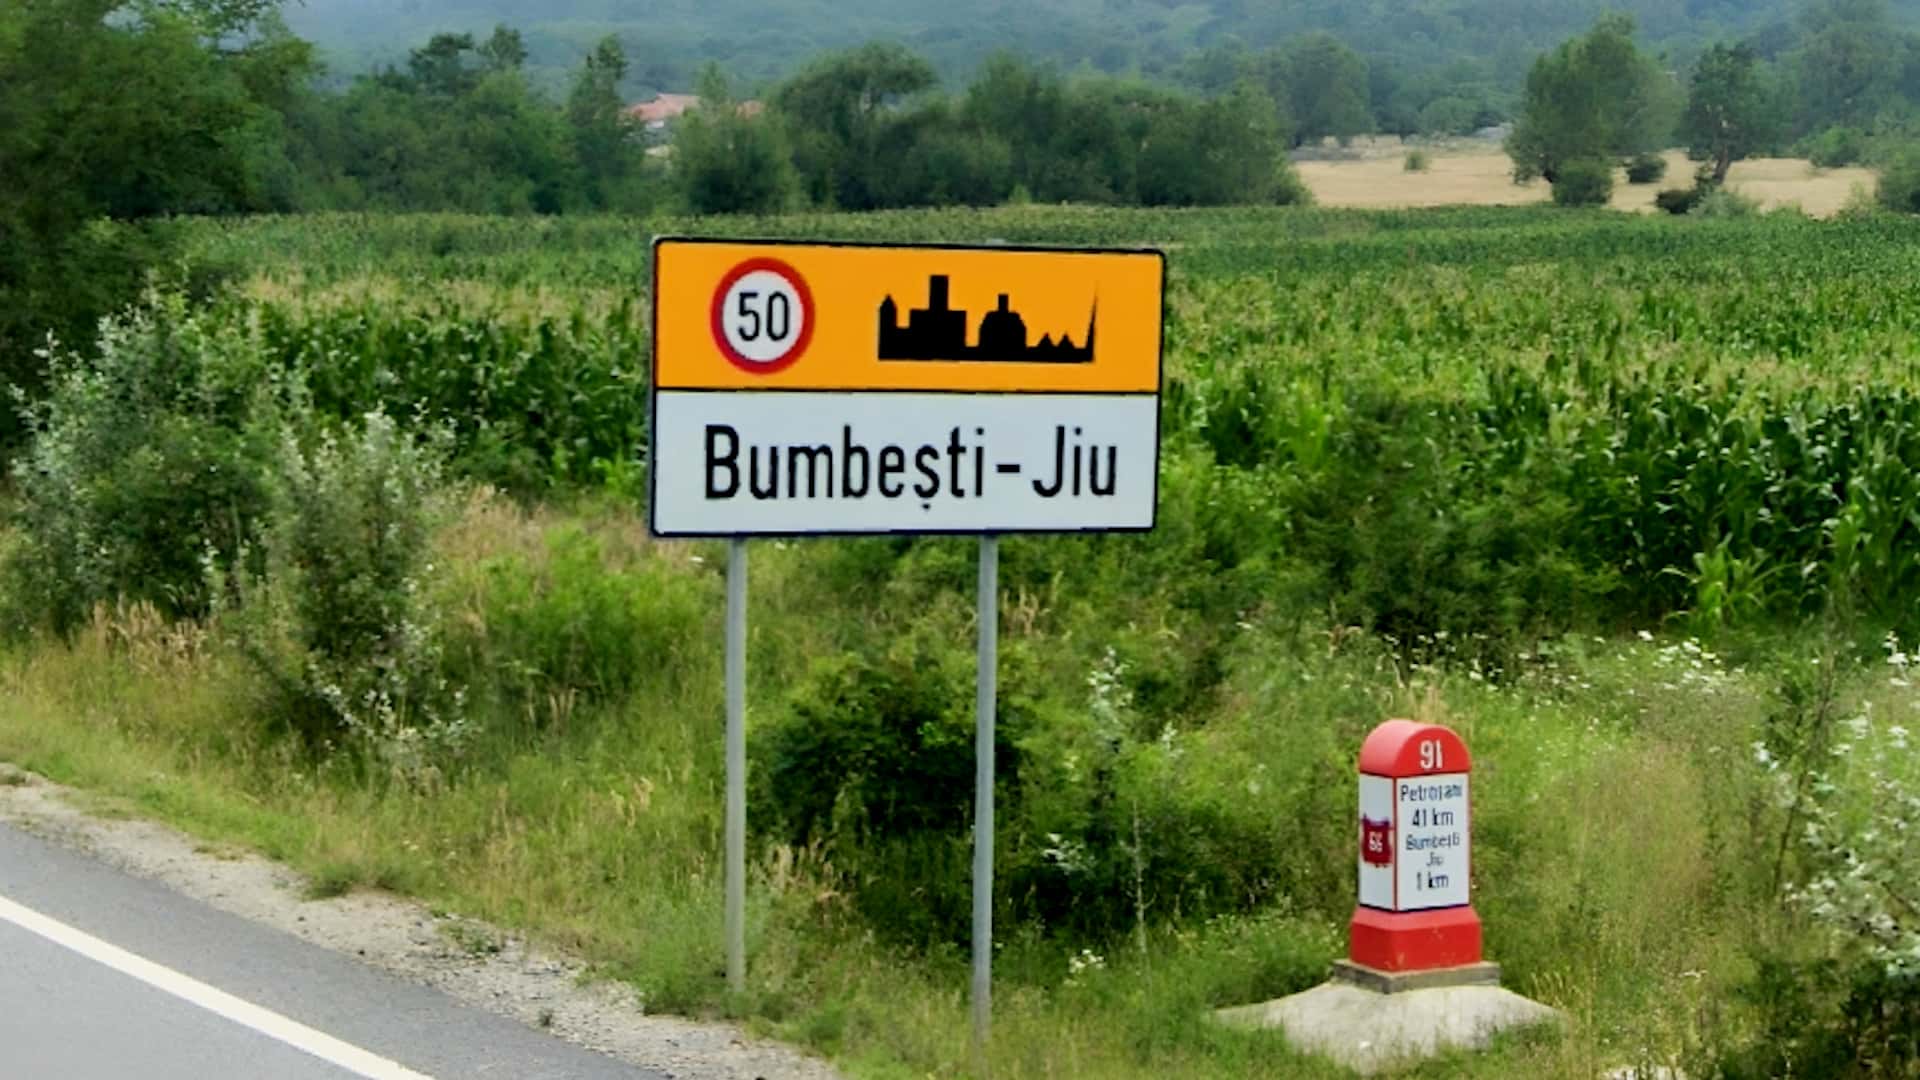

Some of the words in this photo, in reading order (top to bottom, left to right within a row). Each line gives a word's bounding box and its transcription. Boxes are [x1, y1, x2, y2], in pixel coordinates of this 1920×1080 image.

[738, 291, 790, 342] 50
[704, 424, 1117, 511] Bumbești-Jiu
[1419, 738, 1443, 770] 91
[1412, 808, 1427, 827] 41
[1432, 808, 1454, 826] km
[1416, 872, 1422, 892] 1
[1428, 872, 1449, 888] km
